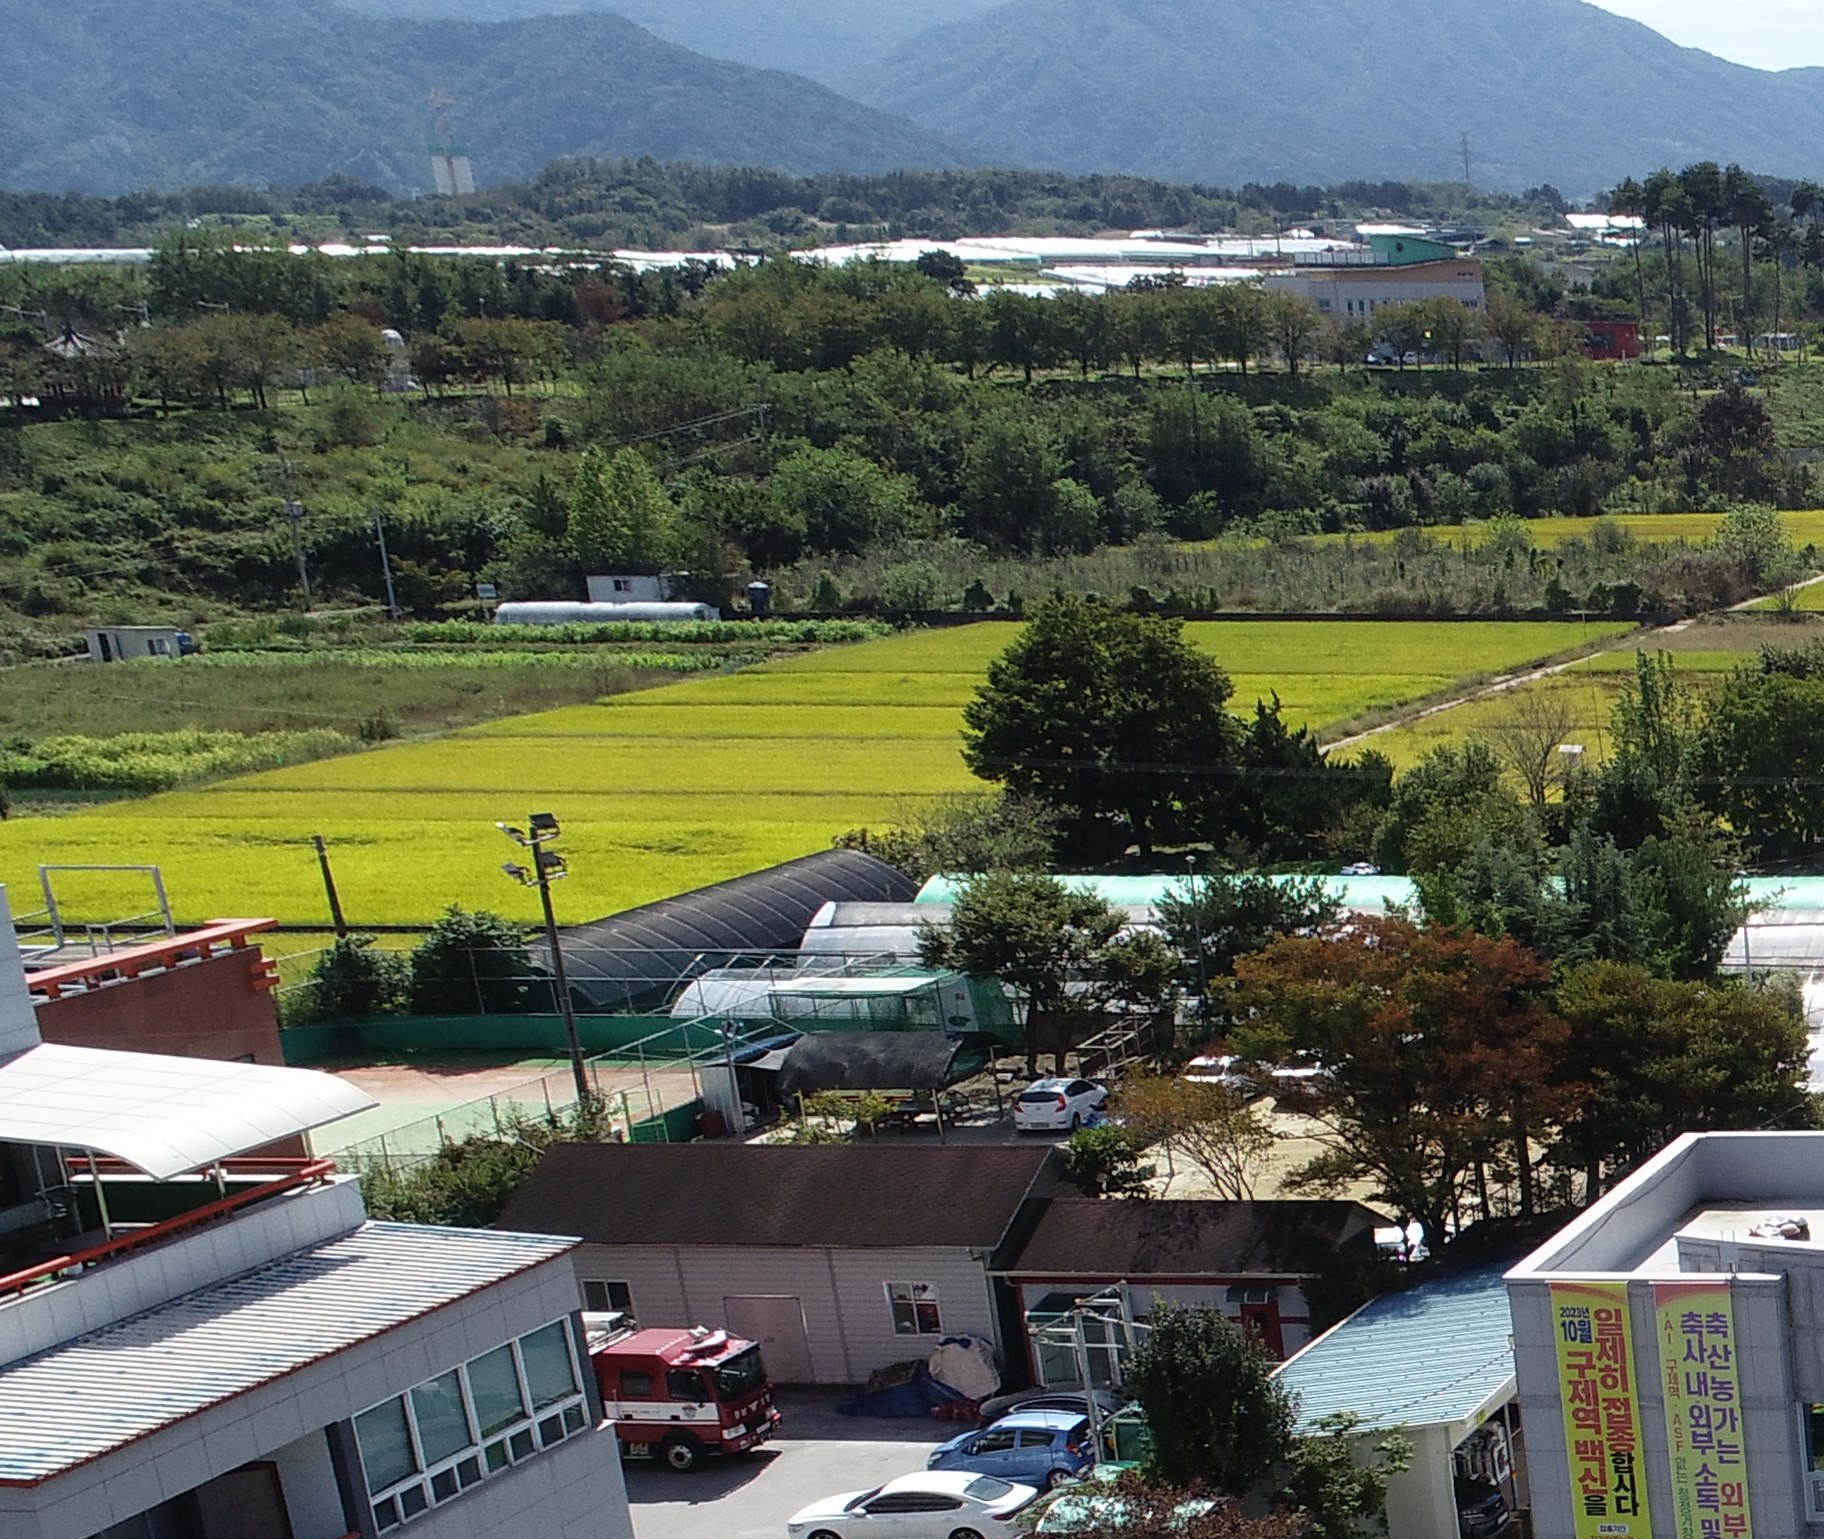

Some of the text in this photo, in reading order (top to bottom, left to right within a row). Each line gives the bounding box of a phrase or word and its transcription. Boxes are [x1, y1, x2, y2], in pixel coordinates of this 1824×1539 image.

[1560, 1307, 1589, 1318] 2023년
[1561, 1320, 1593, 1344] 10월
[1681, 1312, 1707, 1364] 축사
[1594, 1308, 1639, 1516] 일제히 접종합시다
[1705, 1312, 1740, 1464] 축산농가는
[1567, 1351, 1608, 1516] 구제역 백신을
[1673, 1414, 1683, 1452] ASF
[1694, 1463, 1720, 1513] 소독
[1701, 1519, 1721, 1539] 및
